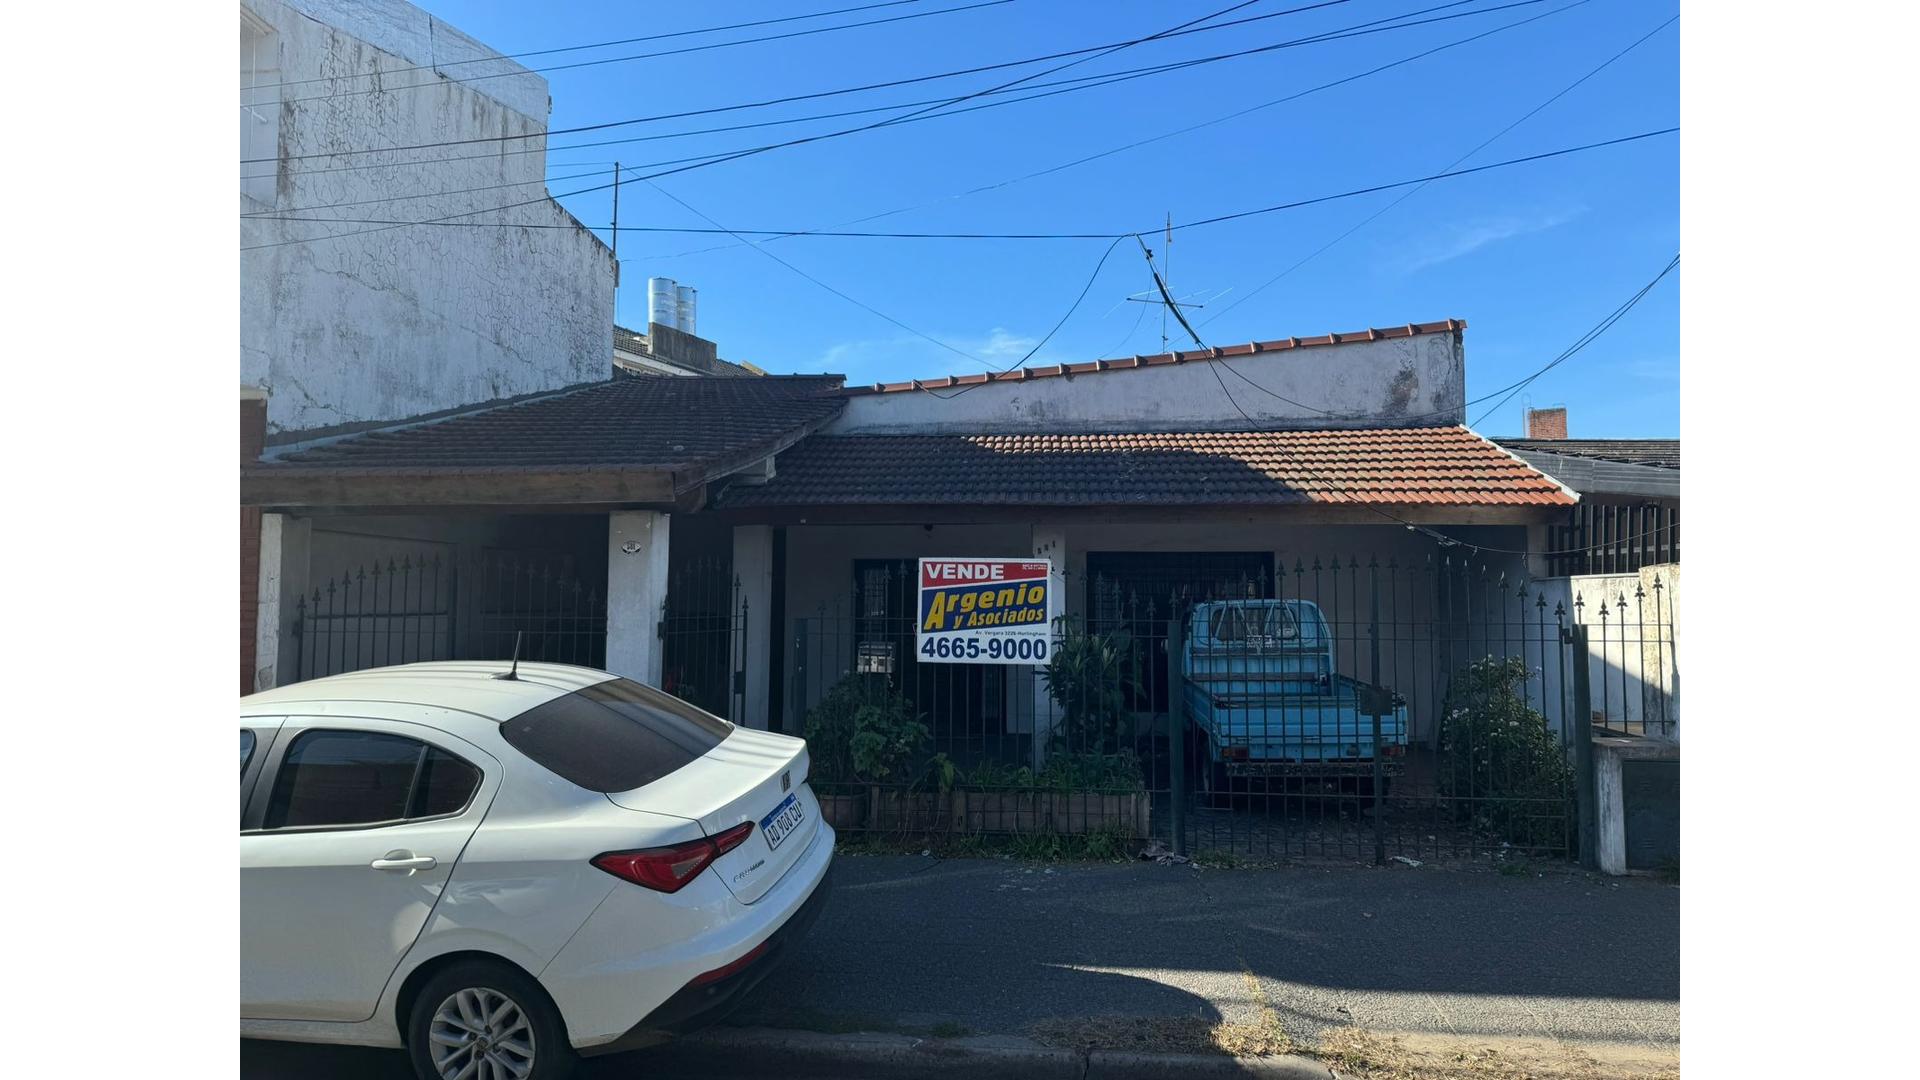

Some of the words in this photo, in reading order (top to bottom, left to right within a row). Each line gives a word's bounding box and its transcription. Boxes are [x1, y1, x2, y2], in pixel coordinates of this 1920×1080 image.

[925, 563, 1004, 579] VENDE
[923, 584, 1045, 630] Argenio
[953, 615, 963, 630] y
[967, 607, 1044, 627] Asociados
[921, 637, 1047, 660] 4665-9000
[767, 824, 780, 845] AD
[789, 803, 802, 821] CU
